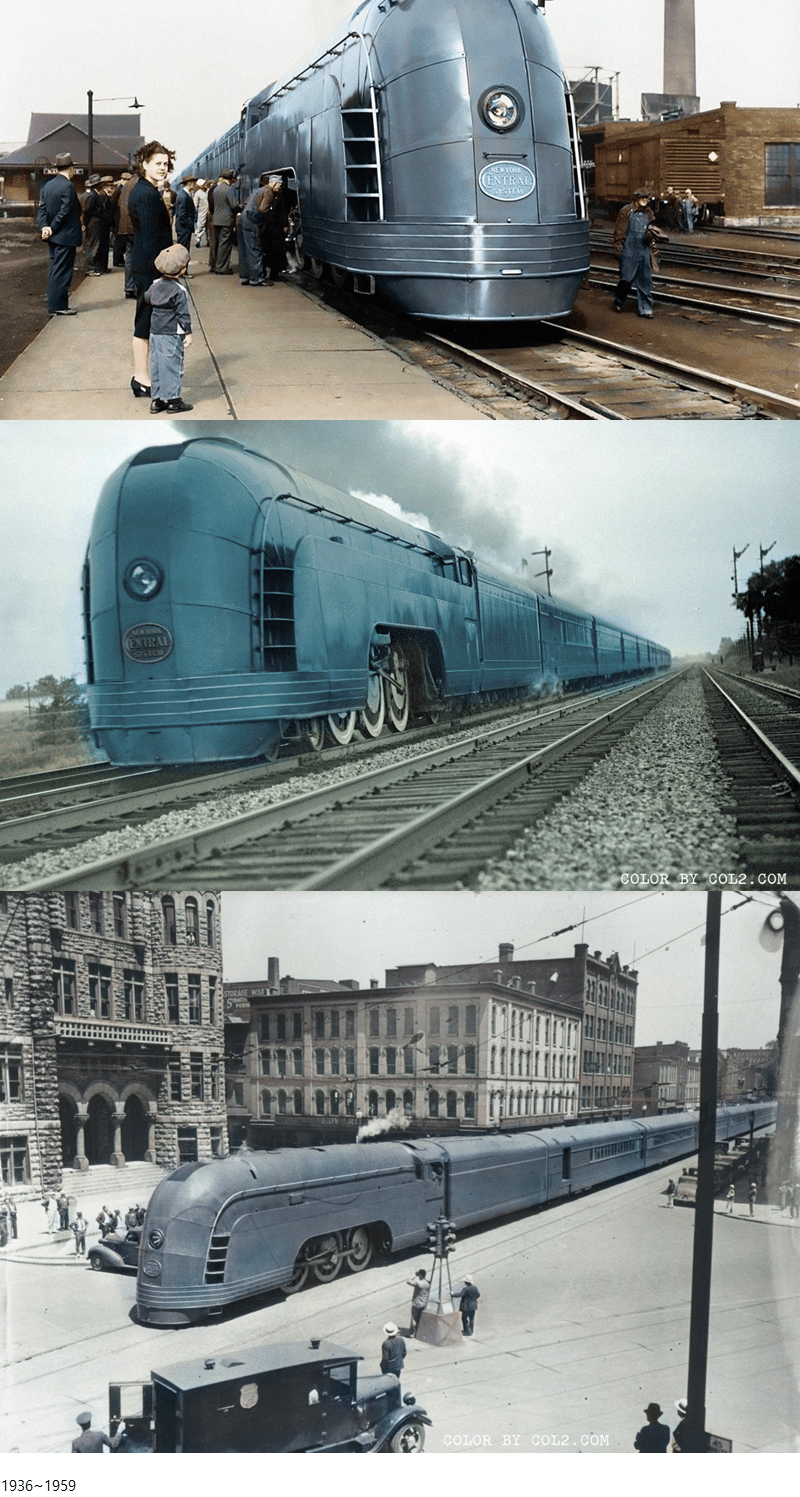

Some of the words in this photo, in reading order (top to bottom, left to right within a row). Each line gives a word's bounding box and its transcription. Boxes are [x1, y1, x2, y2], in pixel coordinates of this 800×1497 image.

[481, 172, 531, 189] CENTRAL
[126, 635, 170, 652] CENTRAL
[223, 989, 248, 998] STORAGE
